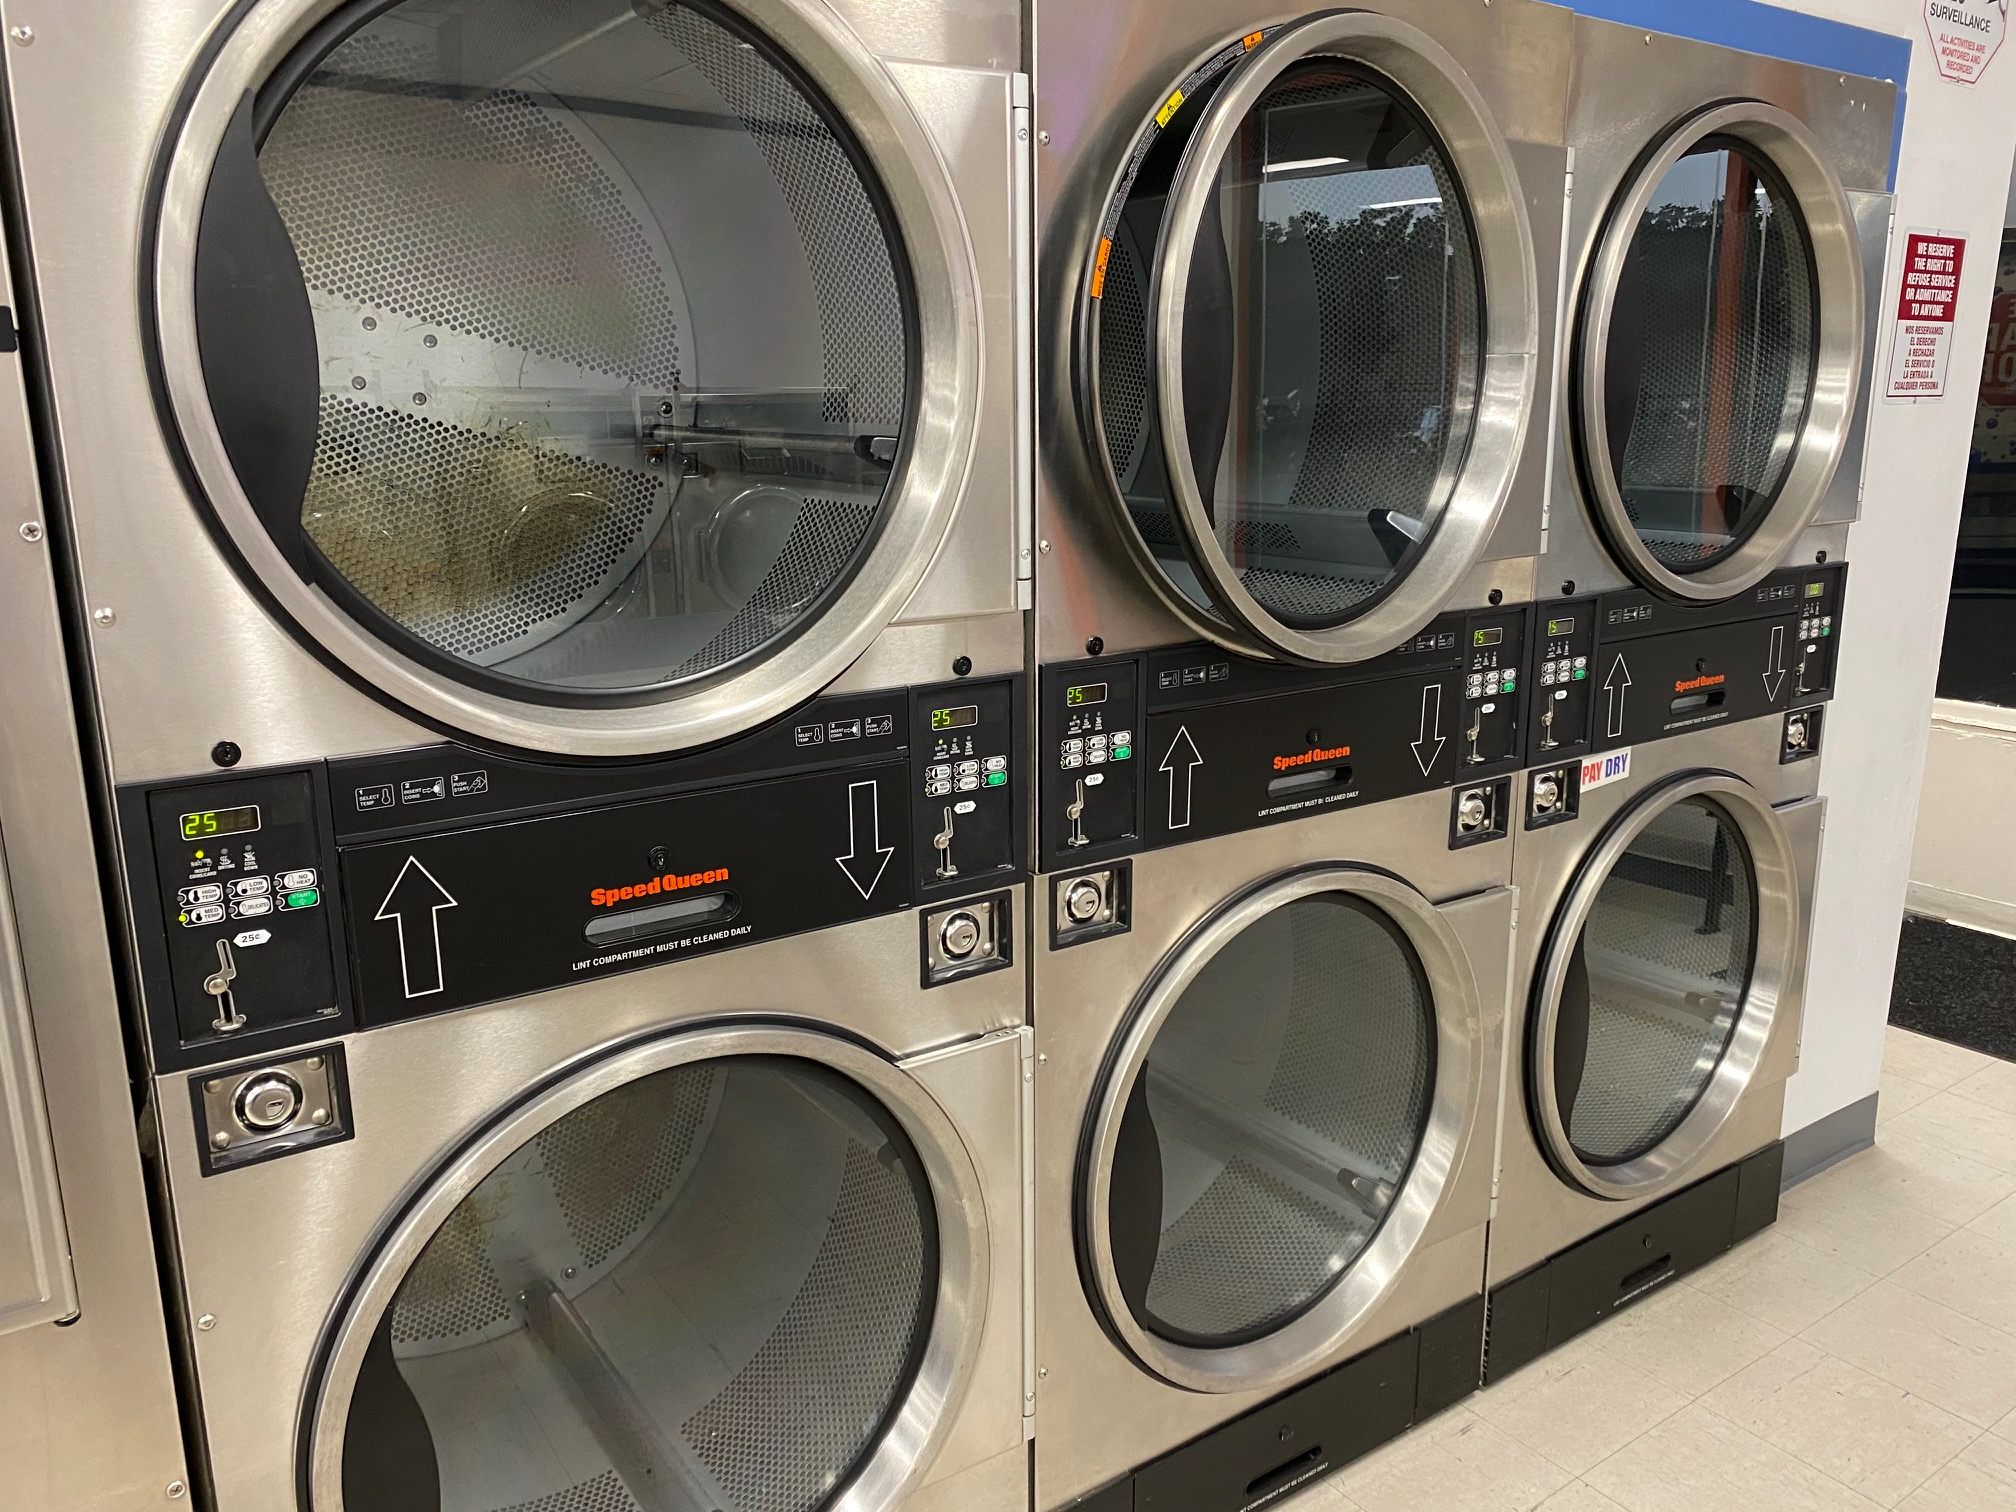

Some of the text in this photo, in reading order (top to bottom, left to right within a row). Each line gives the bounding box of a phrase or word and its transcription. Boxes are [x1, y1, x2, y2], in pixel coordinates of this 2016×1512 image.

[1930, 3, 1991, 33] SURVEILLANCE
[1940, 33, 1986, 54] ALL ACTIVITIES ARE
[1942, 46, 1981, 64] MONITORED AND
[1946, 60, 1973, 74] RECORDED
[1918, 242, 1954, 257] WE RESERVE
[1915, 258, 1954, 272] THE RIGHT TO
[1907, 273, 1956, 287] REFUSE SERVICE
[1906, 288, 1953, 302] OR ADMITTANCE
[1912, 303, 1944, 316] TO ANYONE
[1905, 326, 1944, 335] NOS RESERVAMOS
[1910, 337, 1936, 346] EL DERECHO
[1908, 348, 1935, 357] A RECHAZAR
[1911, 360, 1931, 368] SERVICIO
[1903, 371, 1908, 379] LA
[1894, 382, 1938, 390] CUALQUIER PERSONA
[1675, 675, 1724, 692] Speed Queen
[1273, 746, 1350, 770] Speed Queen
[1582, 753, 1628, 785] PAY DRY
[1270, 802, 1305, 814] COMPARTMENT
[1305, 799, 1317, 807] MUST
[1325, 794, 1346, 803] CLEANED
[186, 813, 216, 834] 25
[591, 868, 729, 906] Speed Queen
[247, 902, 270, 910] DELICATES
[242, 934, 260, 942] 25¢
[572, 960, 591, 970] LINT
[593, 947, 655, 966] COMPARTMENT
[657, 941, 678, 953] MUST
[693, 930, 729, 944] CLEANED
[731, 925, 752, 936] DAILY
